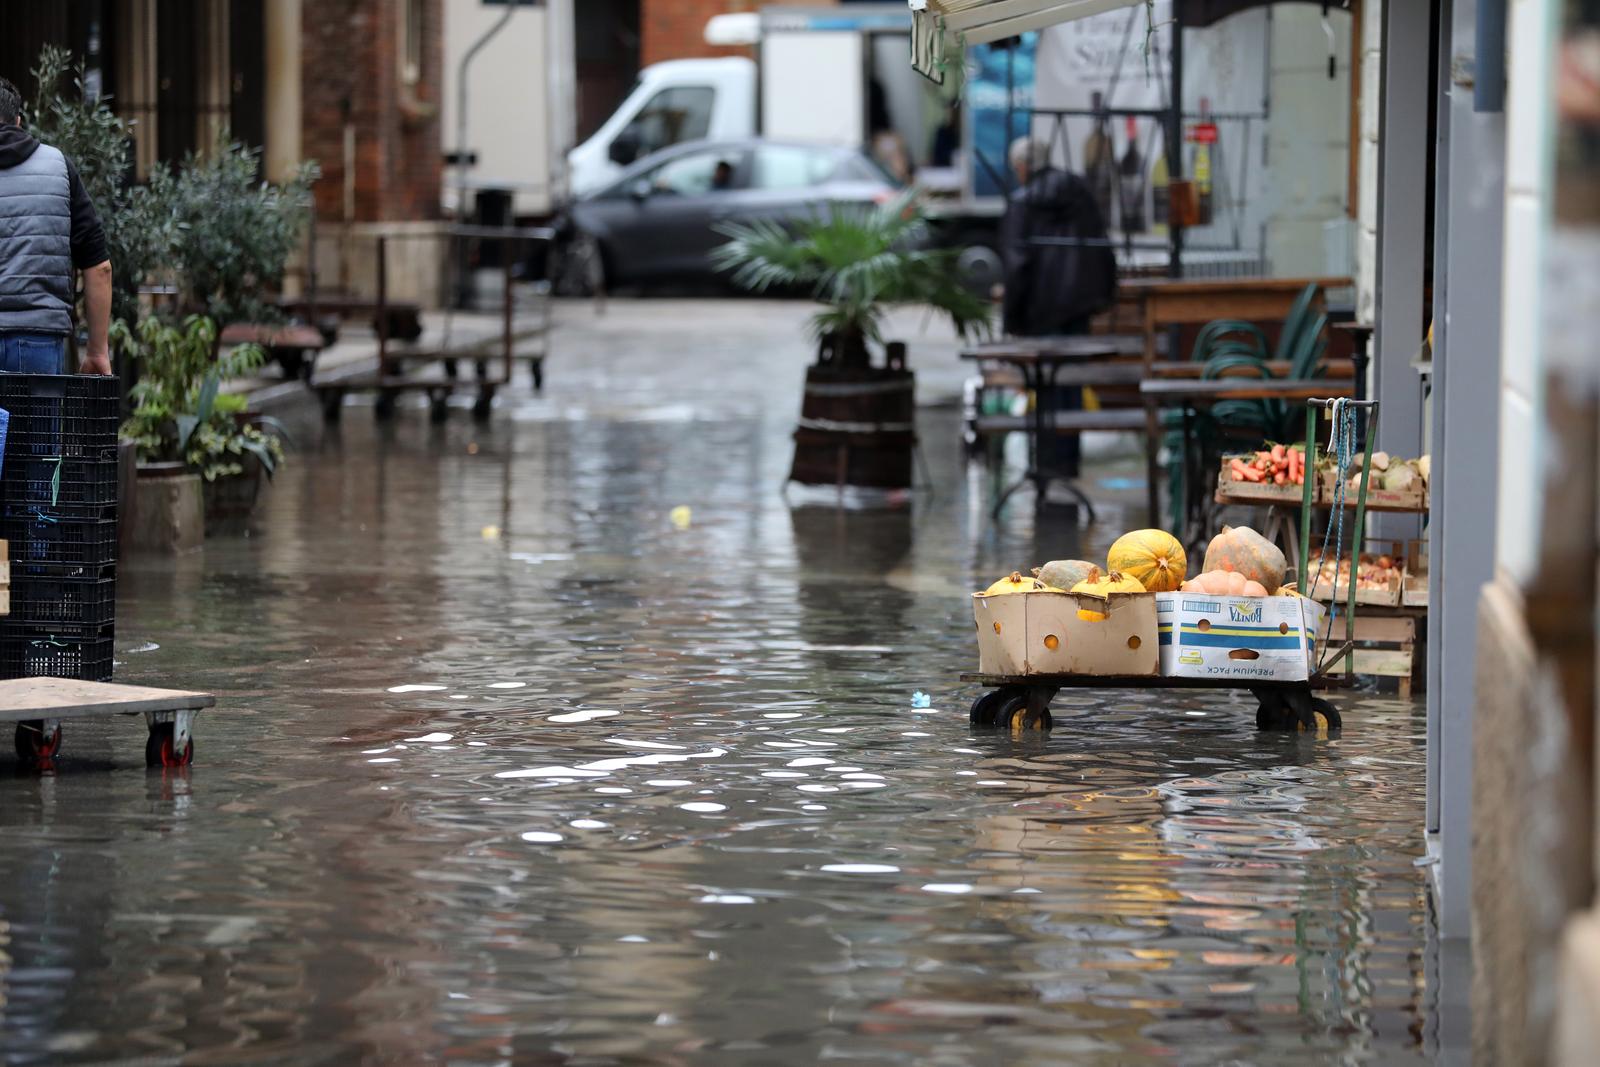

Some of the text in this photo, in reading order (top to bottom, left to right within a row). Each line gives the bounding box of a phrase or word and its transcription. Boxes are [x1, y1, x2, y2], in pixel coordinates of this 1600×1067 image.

[1229, 606, 1262, 623] BONITA
[1207, 666, 1274, 676] PREMIUM PACK
